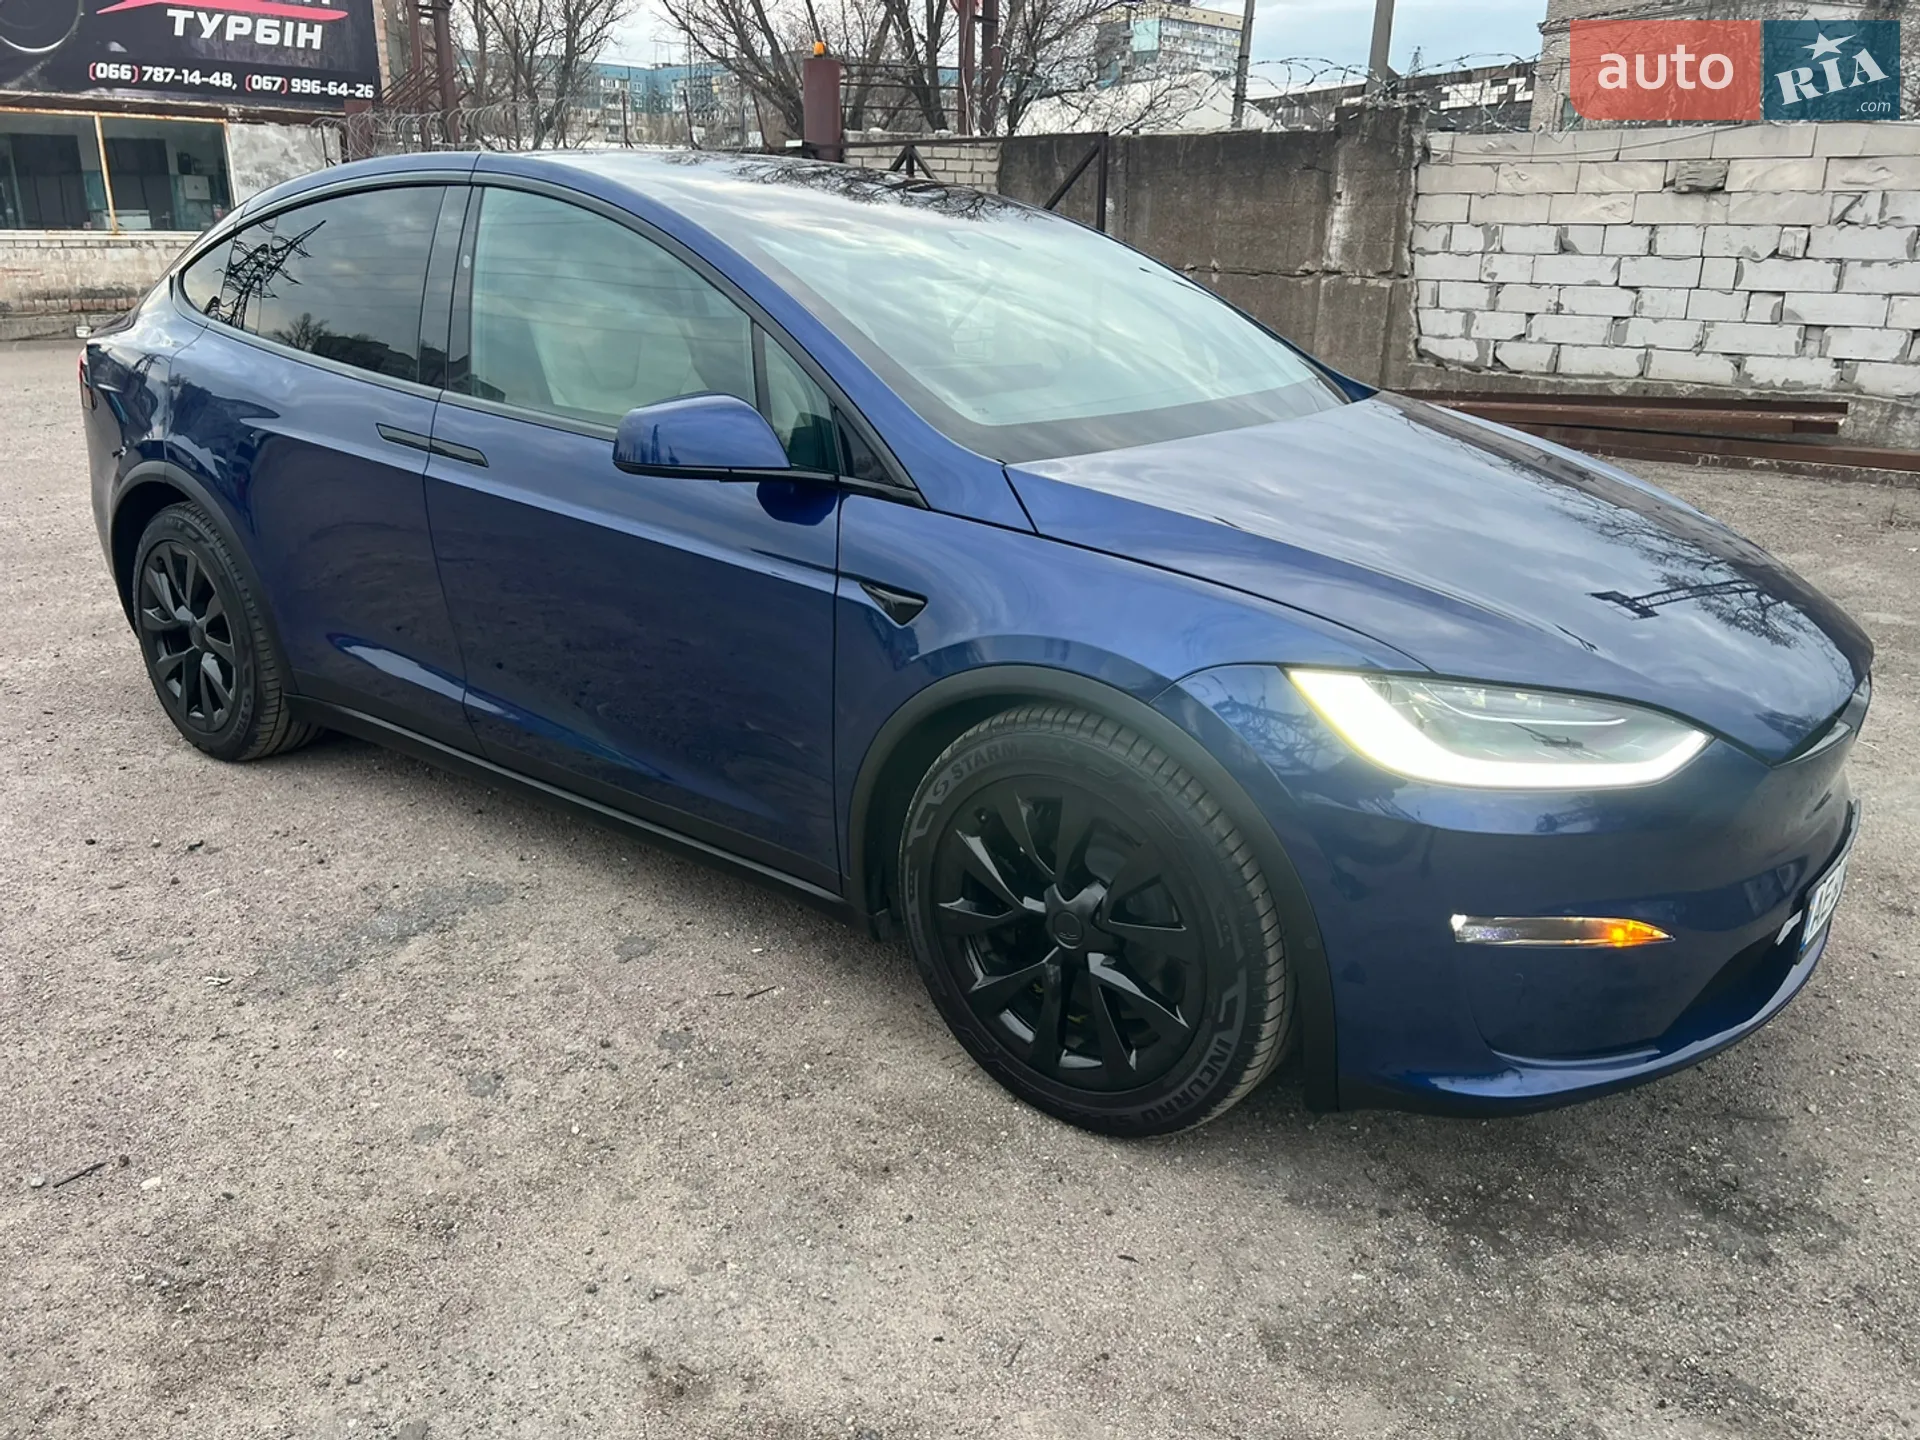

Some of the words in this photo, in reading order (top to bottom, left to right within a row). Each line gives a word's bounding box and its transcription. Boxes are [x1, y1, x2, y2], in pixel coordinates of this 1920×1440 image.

[166, 8, 323, 50] ТУРБІН
[89, 62, 139, 83] (066)
[245, 74, 288, 95] (067)
[290, 77, 374, 99] 996-64-26
